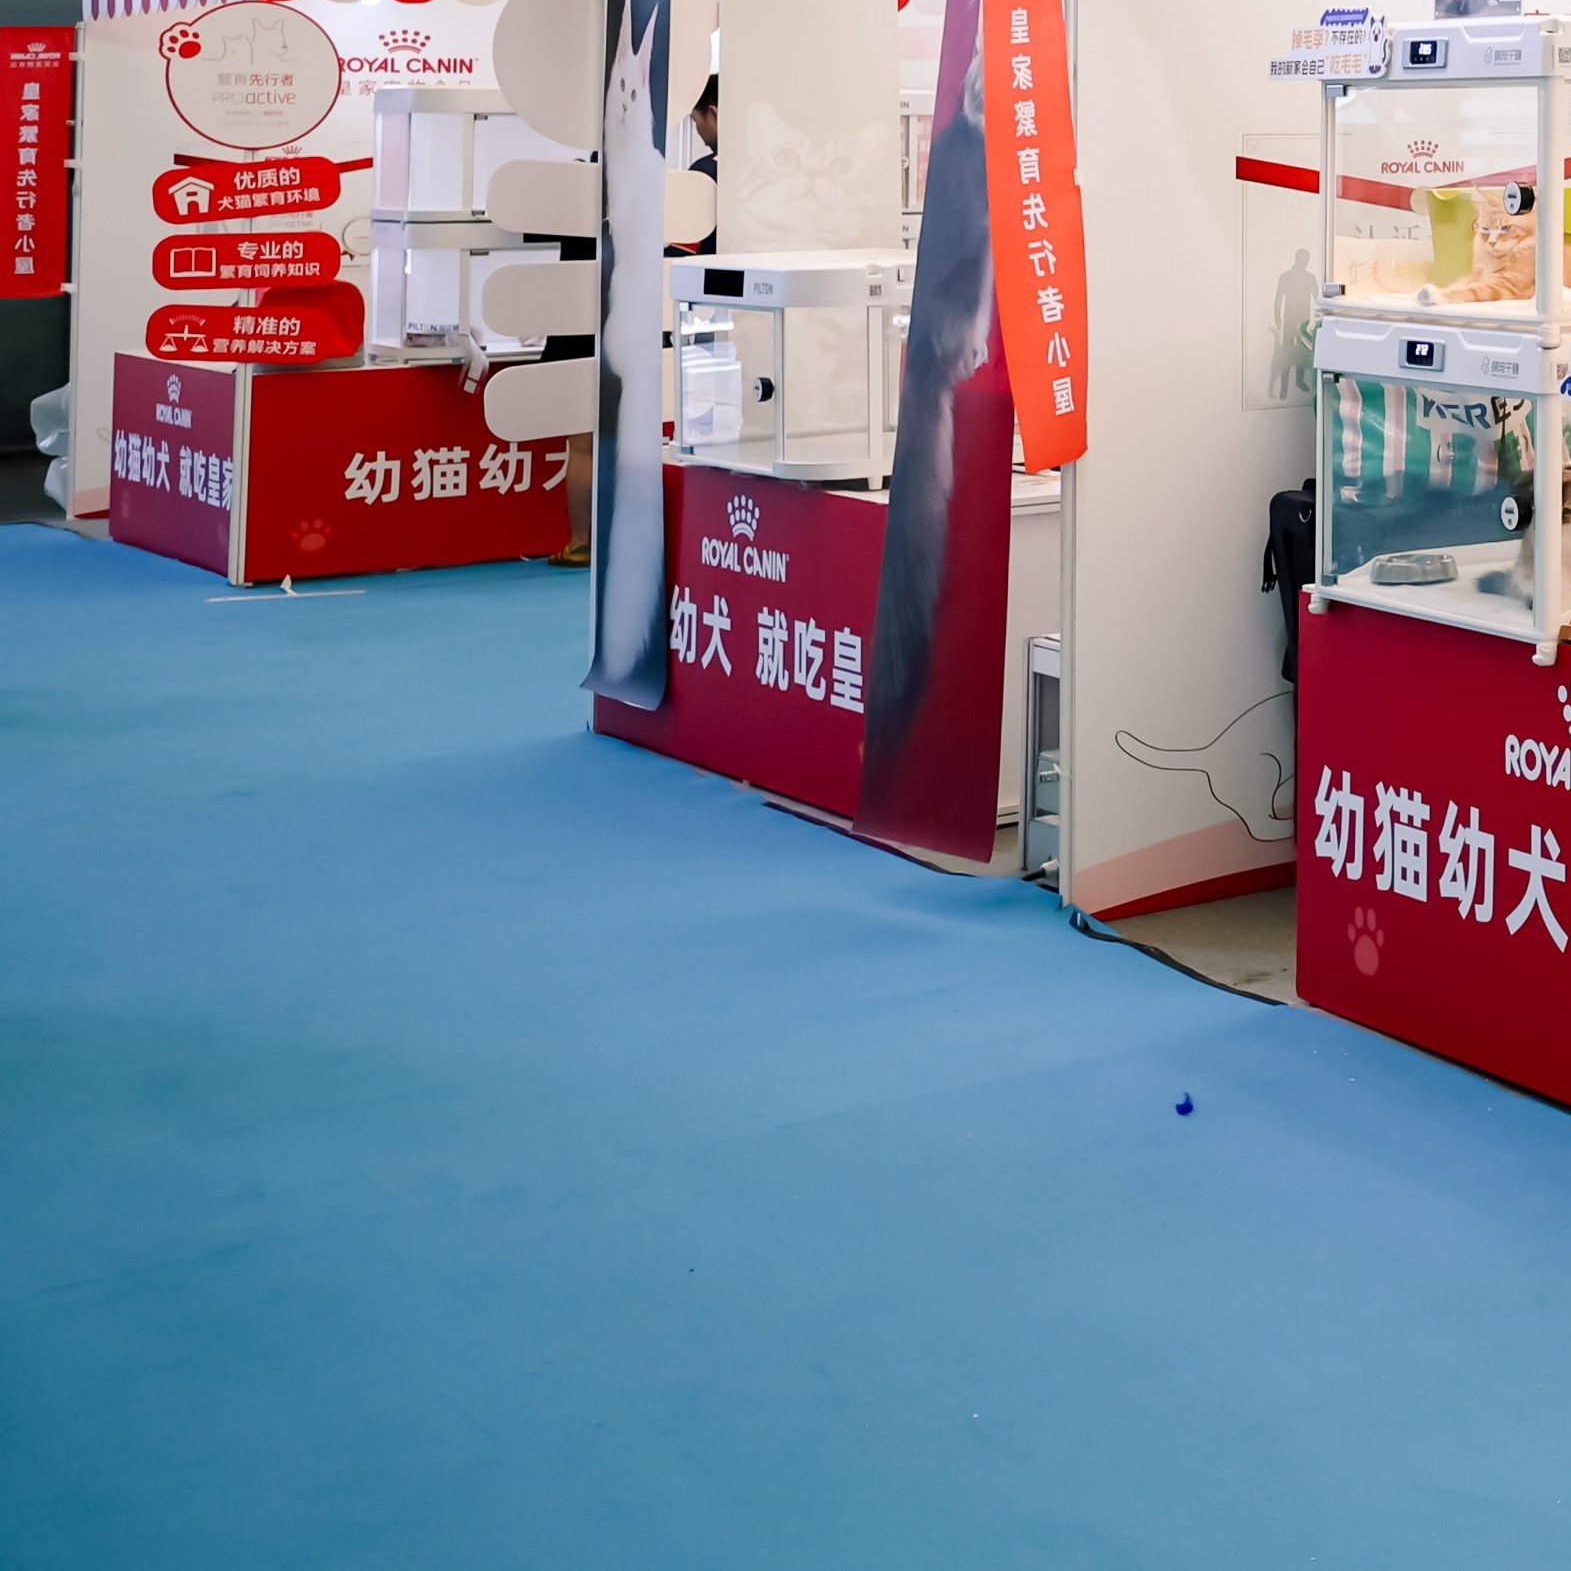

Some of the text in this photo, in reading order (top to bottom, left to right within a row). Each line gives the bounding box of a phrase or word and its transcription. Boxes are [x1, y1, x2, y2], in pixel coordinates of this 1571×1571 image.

[406, 57, 474, 74] CANIN
[217, 72, 294, 87] 繁育先行者
[211, 90, 297, 105] PROactive
[1381, 160, 1465, 175] ROYAL CANIN
[234, 166, 301, 191] 优质的
[217, 187, 321, 212] 犬猫繁育环境
[237, 240, 304, 261] 专业的
[219, 260, 320, 280] 繁育饲养知识
[232, 314, 301, 337] 精准的
[212, 336, 317, 356] 营养解决方案
[114, 429, 234, 512] 幼猫幼犬 就吃皇家
[701, 536, 787, 583] ROYAL CANIN
[1313, 765, 1570, 953] 幼猫幼犬
